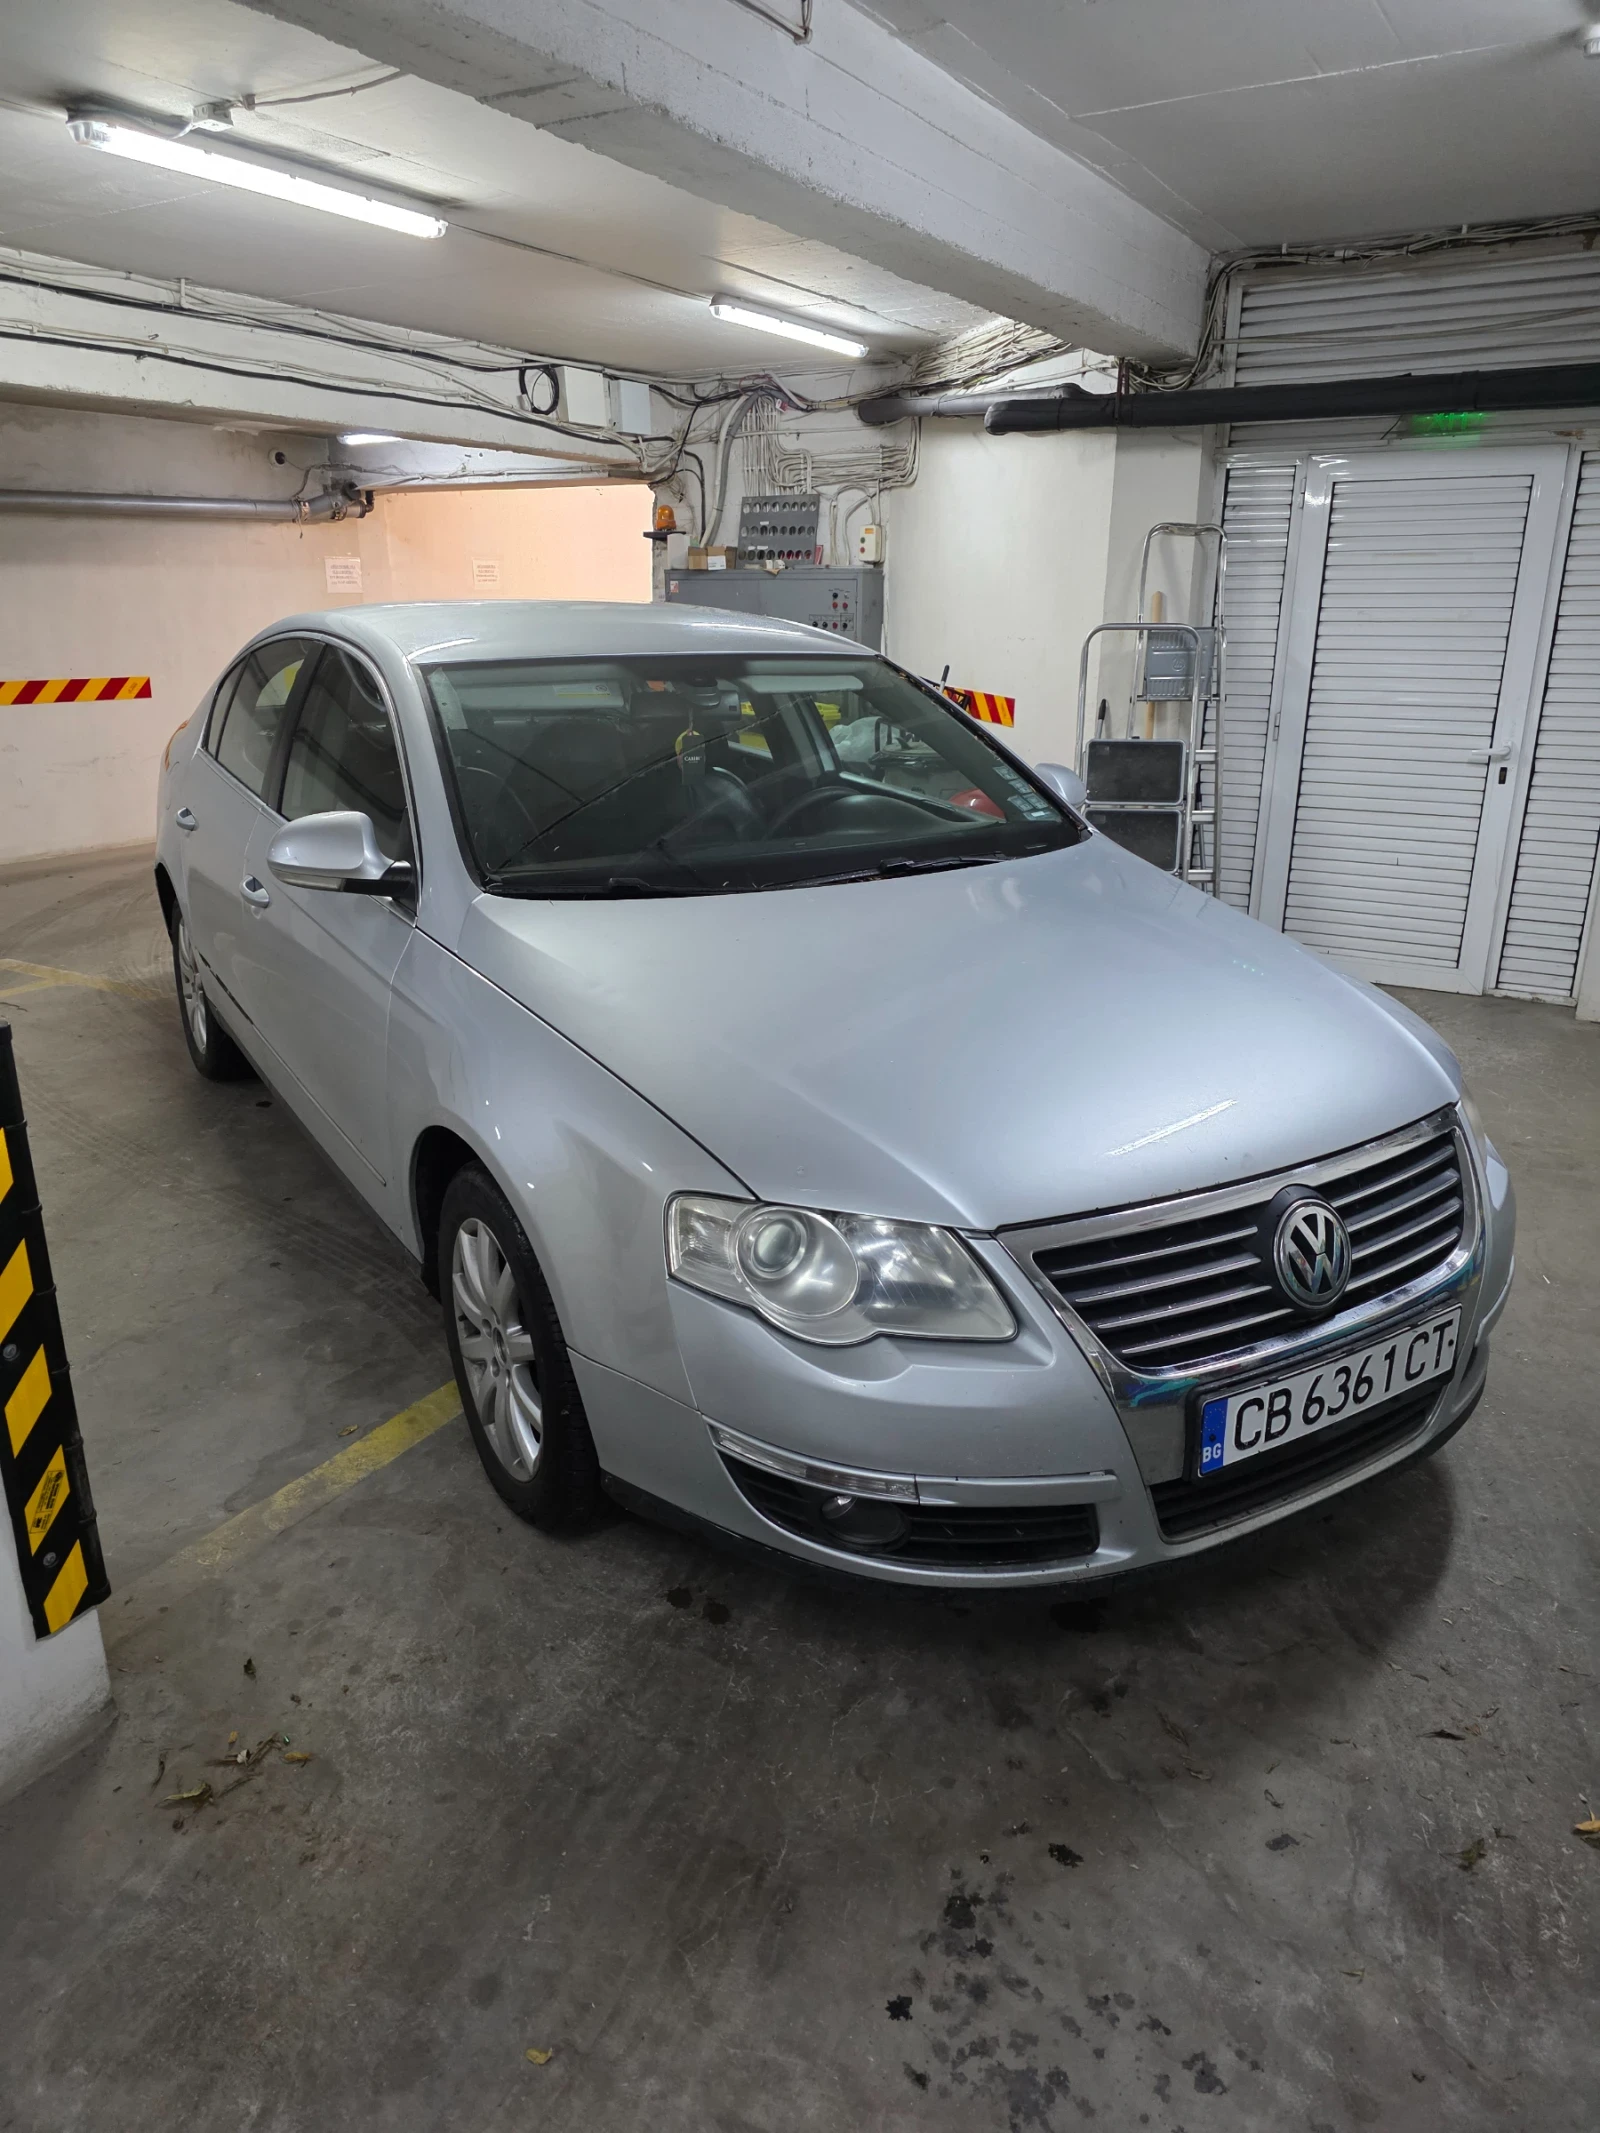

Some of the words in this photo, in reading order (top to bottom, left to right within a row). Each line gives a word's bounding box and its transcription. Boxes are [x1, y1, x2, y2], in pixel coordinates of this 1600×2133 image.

[1284, 1207, 1344, 1299] VW
[1302, 1345, 1397, 1425] 6361
[1202, 1443, 1223, 1463] BG
